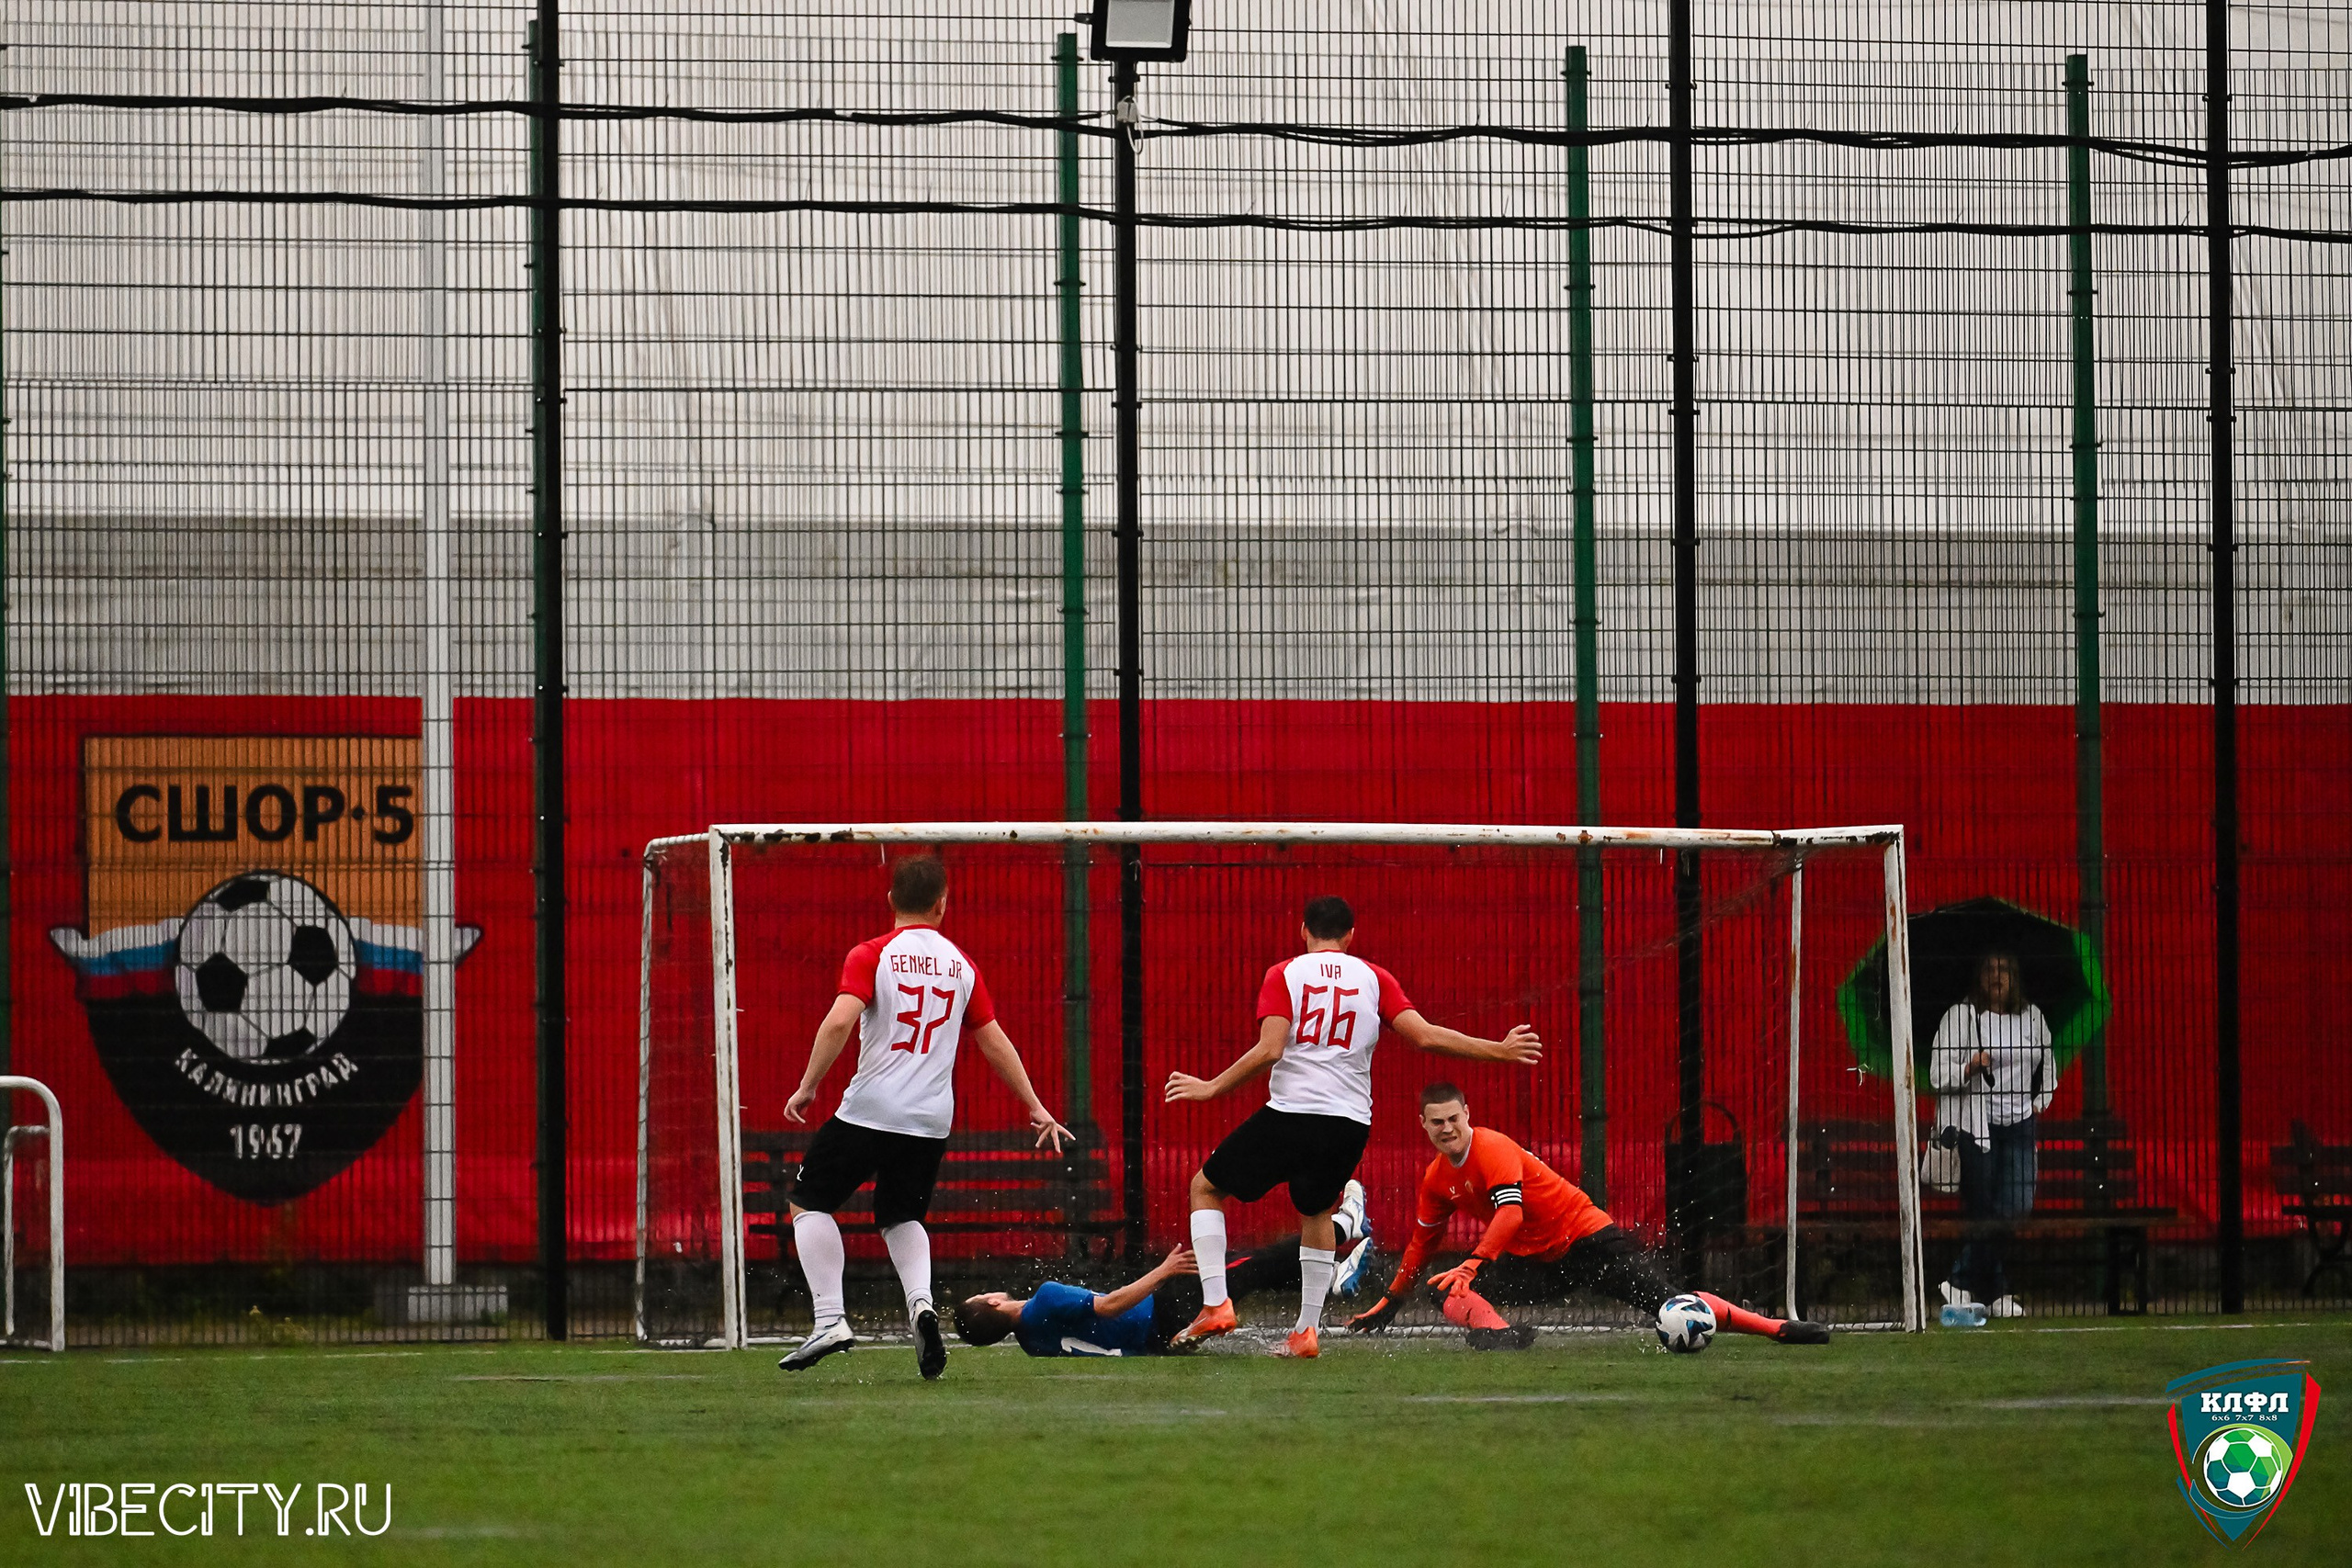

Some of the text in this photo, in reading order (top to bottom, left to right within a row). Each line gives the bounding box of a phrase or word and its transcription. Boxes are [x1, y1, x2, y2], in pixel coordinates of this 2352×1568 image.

[890, 954, 962, 980] GENKEL JR
[1320, 964, 1341, 980] IVA
[890, 983, 956, 1055] 37
[1295, 983, 1360, 1051] 66
[175, 1047, 359, 1106] КАЛИНИНГРАД
[230, 1123, 302, 1159] 1967
